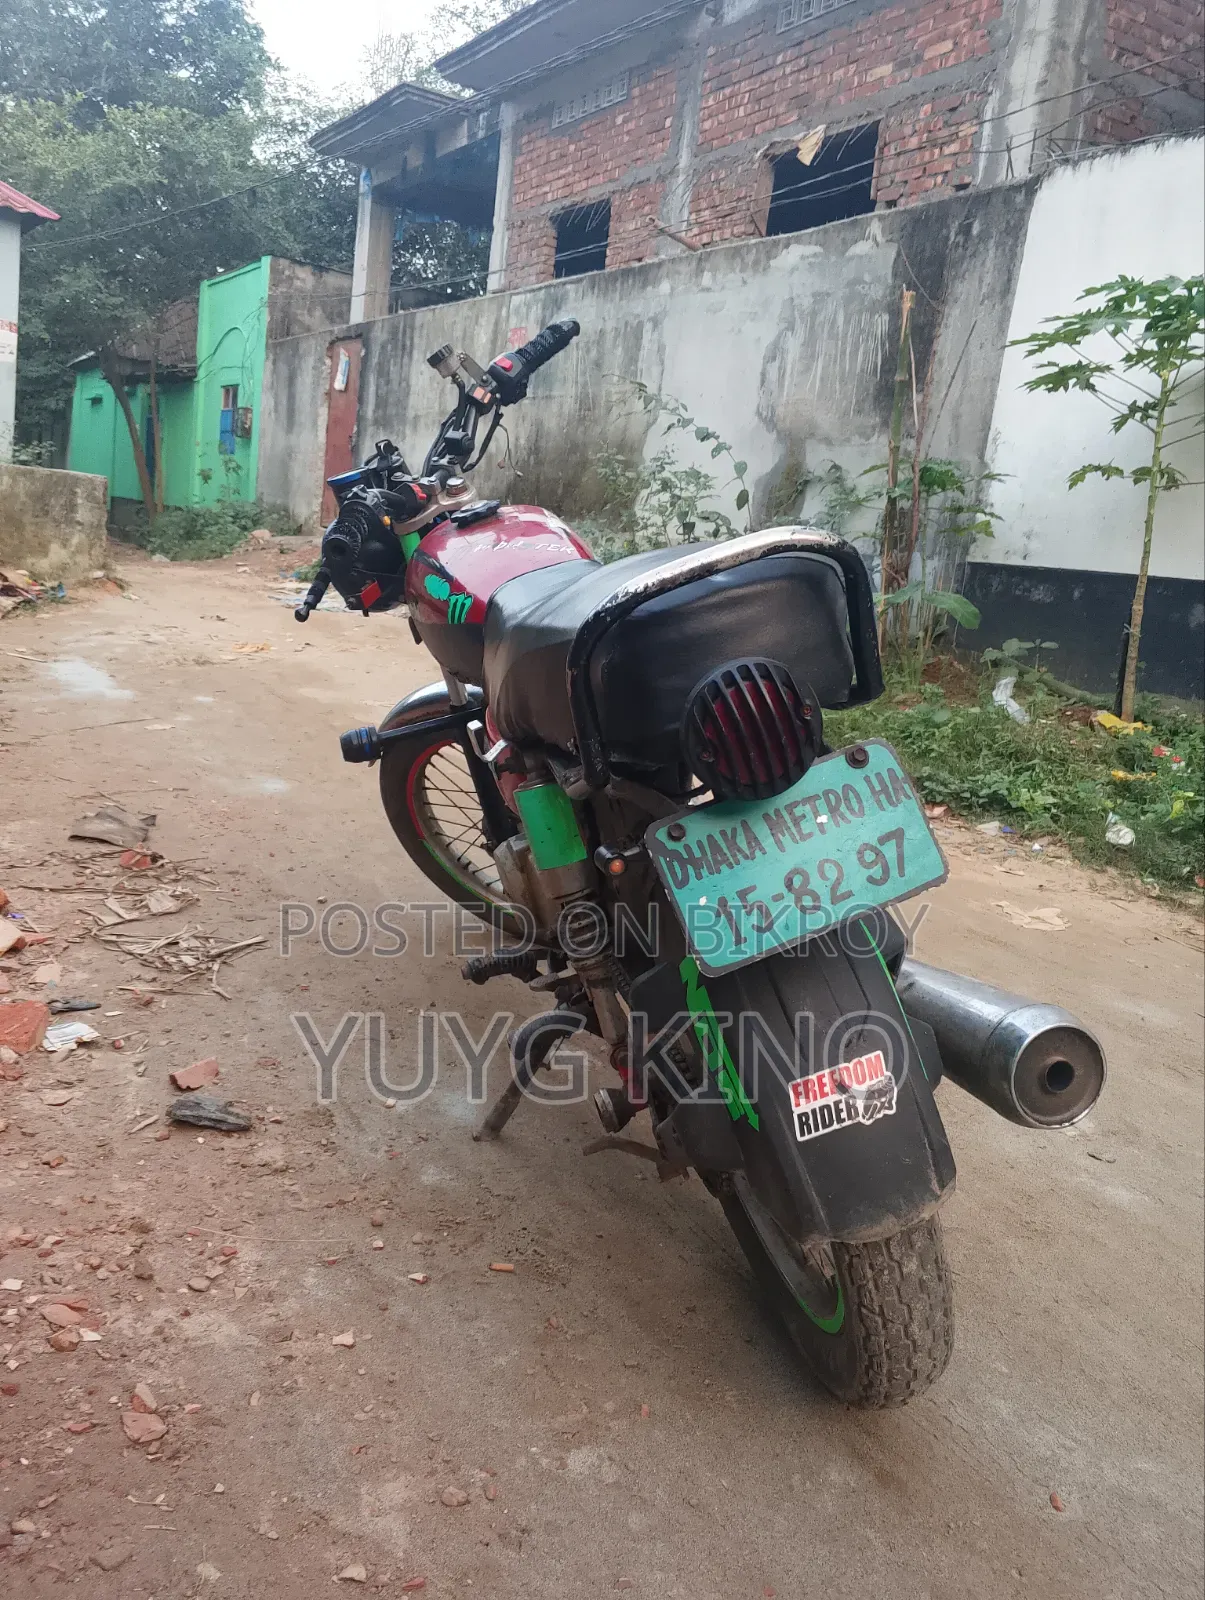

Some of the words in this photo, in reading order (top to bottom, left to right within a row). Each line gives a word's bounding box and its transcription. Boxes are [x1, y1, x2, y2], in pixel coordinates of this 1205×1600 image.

[659, 819, 767, 889] DHAKA
[762, 783, 866, 854] METRO
[791, 1053, 885, 1108] FREEDOM
[796, 1095, 860, 1138] RIDER
